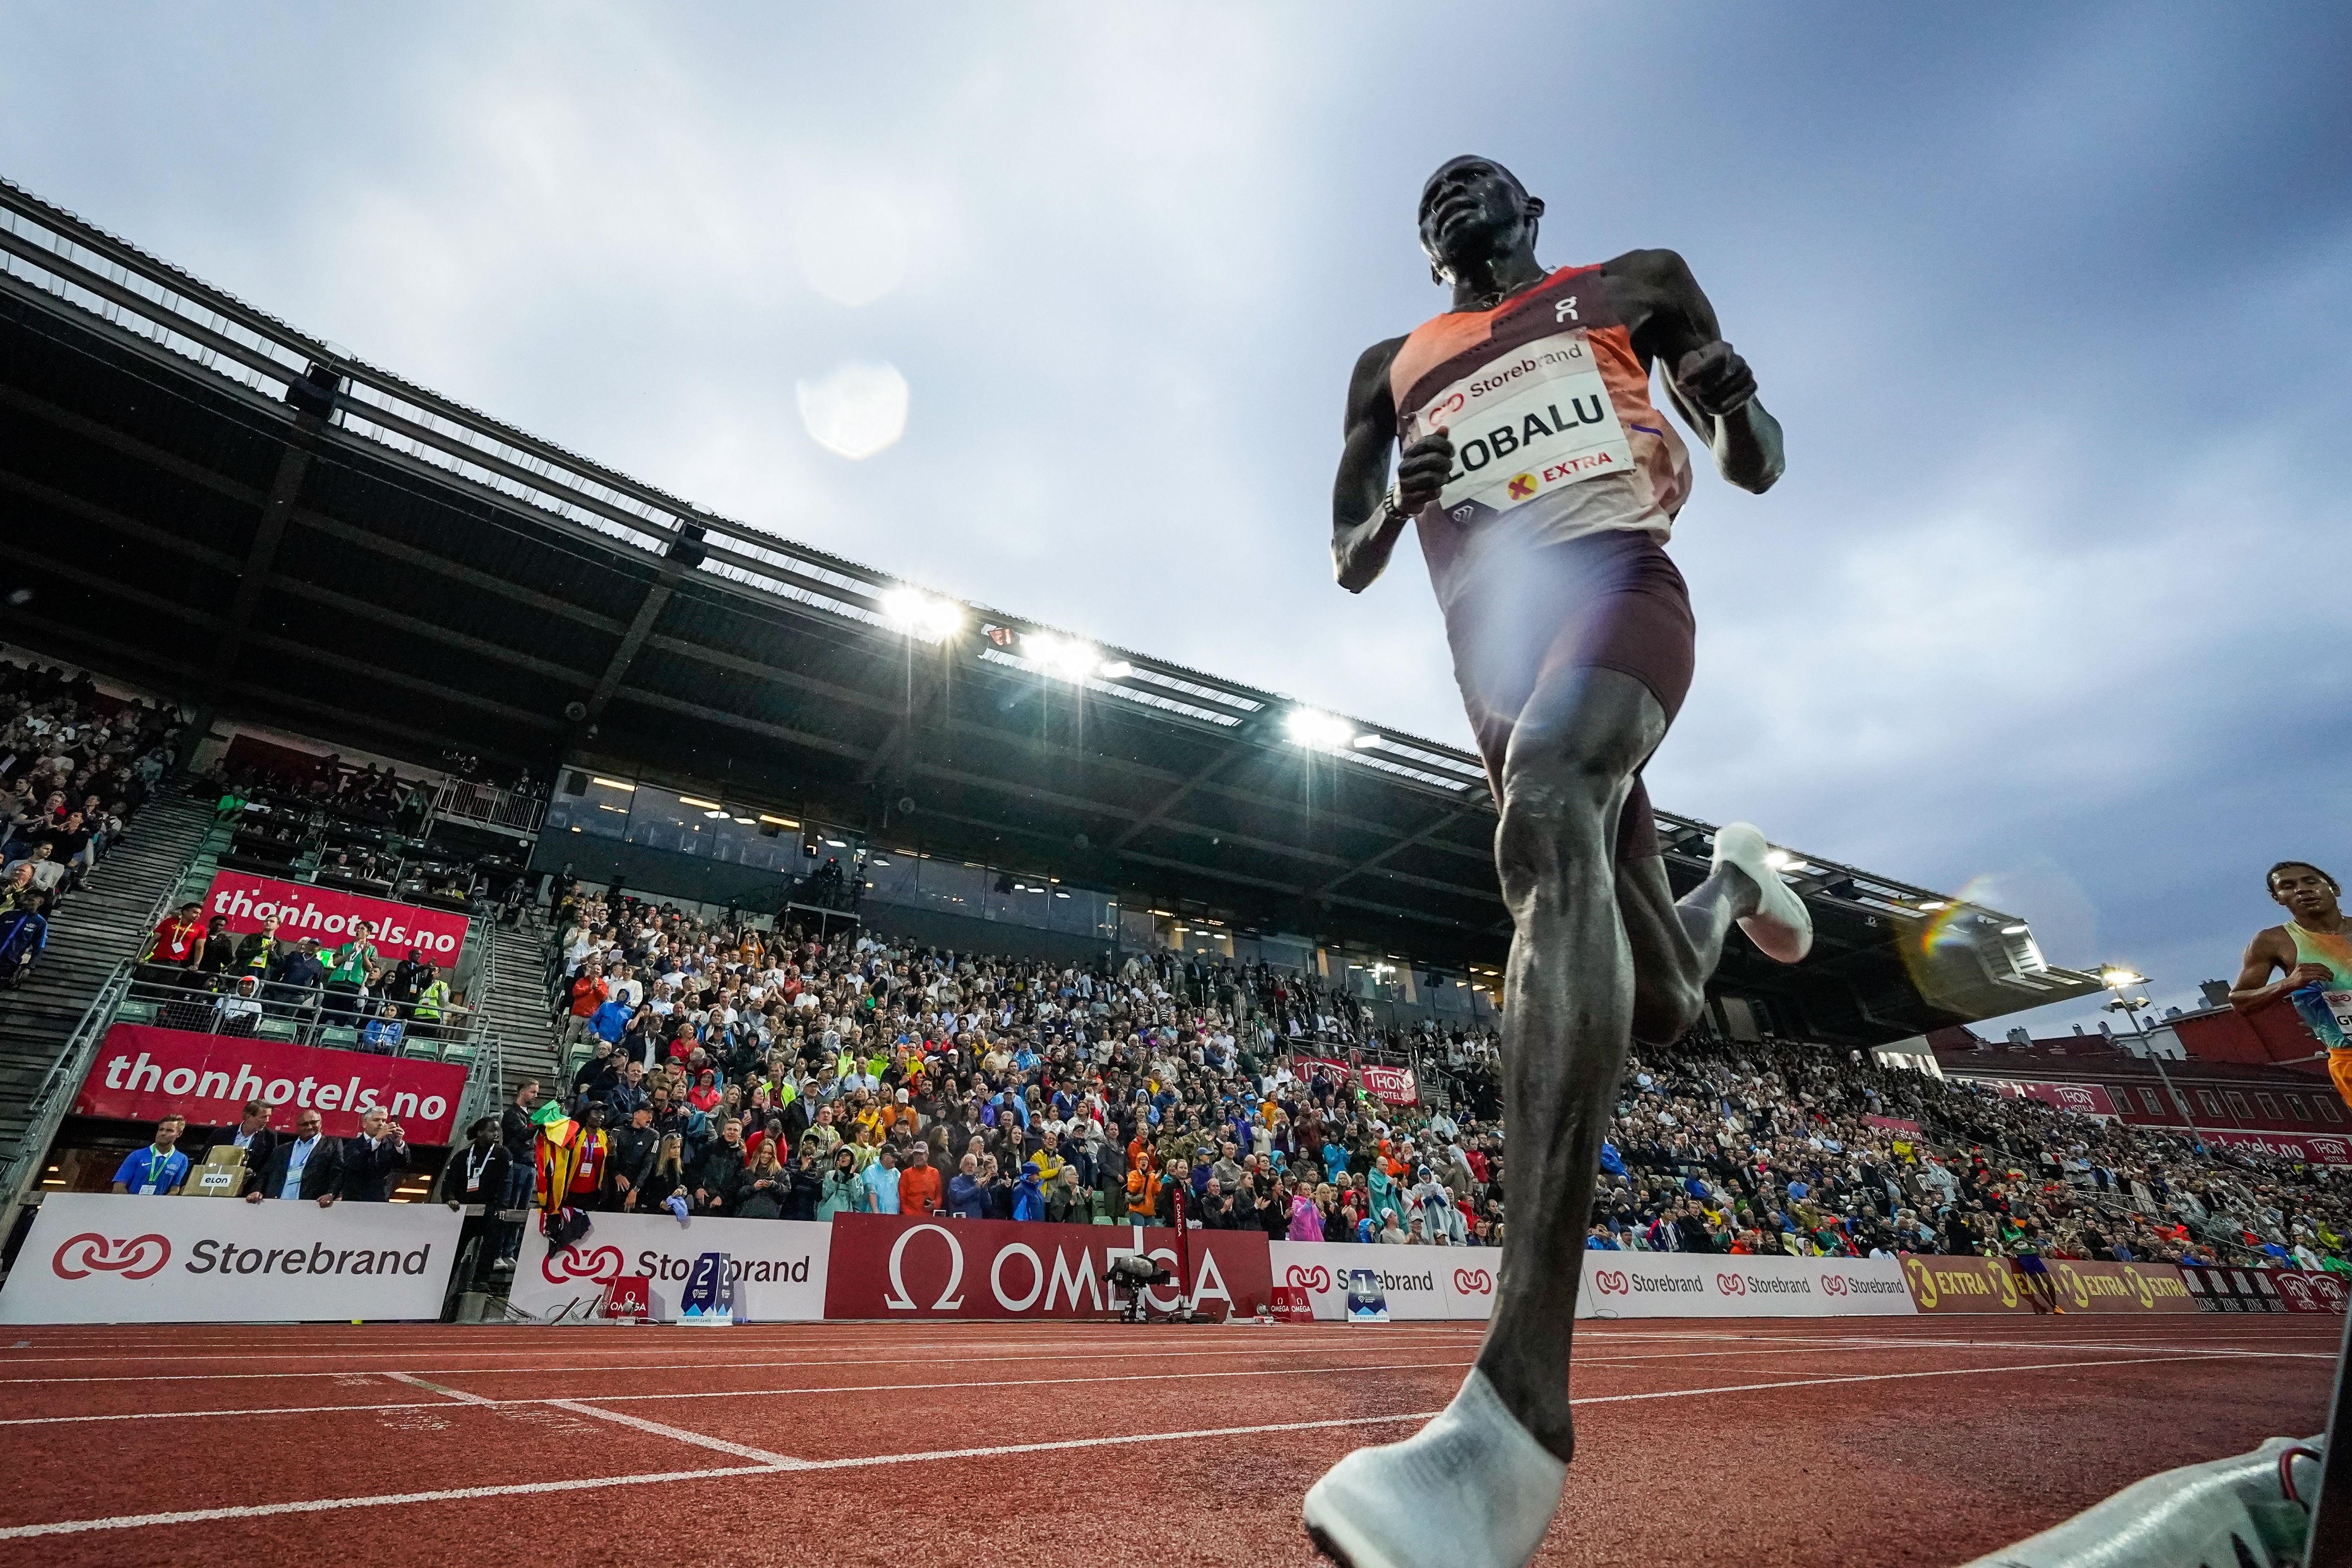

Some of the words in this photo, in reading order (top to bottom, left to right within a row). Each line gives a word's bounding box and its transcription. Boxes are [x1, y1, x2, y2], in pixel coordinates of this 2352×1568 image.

[1469, 343, 1583, 398] Storebrand
[1542, 451, 1613, 483] EXTRA
[214, 890, 455, 953] thonhotels.no
[105, 1052, 446, 1121] thonhotelsno
[1364, 1070, 1408, 1090] THON
[1377, 1090, 1405, 1100] HOTELS
[2054, 1087, 2094, 1105] THON
[2307, 1138, 2346, 1154] THON
[185, 1239, 431, 1275] Storebrand
[635, 1251, 810, 1282] Storand
[696, 1259, 713, 1285] 2
[723, 1259, 729, 1286] 2
[990, 1242, 1236, 1312] OMEGA
[1337, 1269, 1434, 1290] Sebrand
[1358, 1274, 1371, 1293] 1
[1632, 1273, 1703, 1293] Storebrand
[1748, 1276, 1811, 1293] Storebrand
[1848, 1277, 1904, 1294] Storebrand
[1935, 1272, 1990, 1294] EXTRA
[2082, 1275, 2131, 1296] EXTRA
[2146, 1277, 2191, 1297] EXTRA
[2277, 1273, 2312, 1296] THON
[2312, 1275, 2344, 1298] THON
[610, 1302, 646, 1312] OGA
[2195, 1298, 2219, 1311] ZONE
[2220, 1298, 2243, 1311] ZONE
[2244, 1298, 2266, 1311] ZONE
[2266, 1299, 2288, 1311] ZONE
